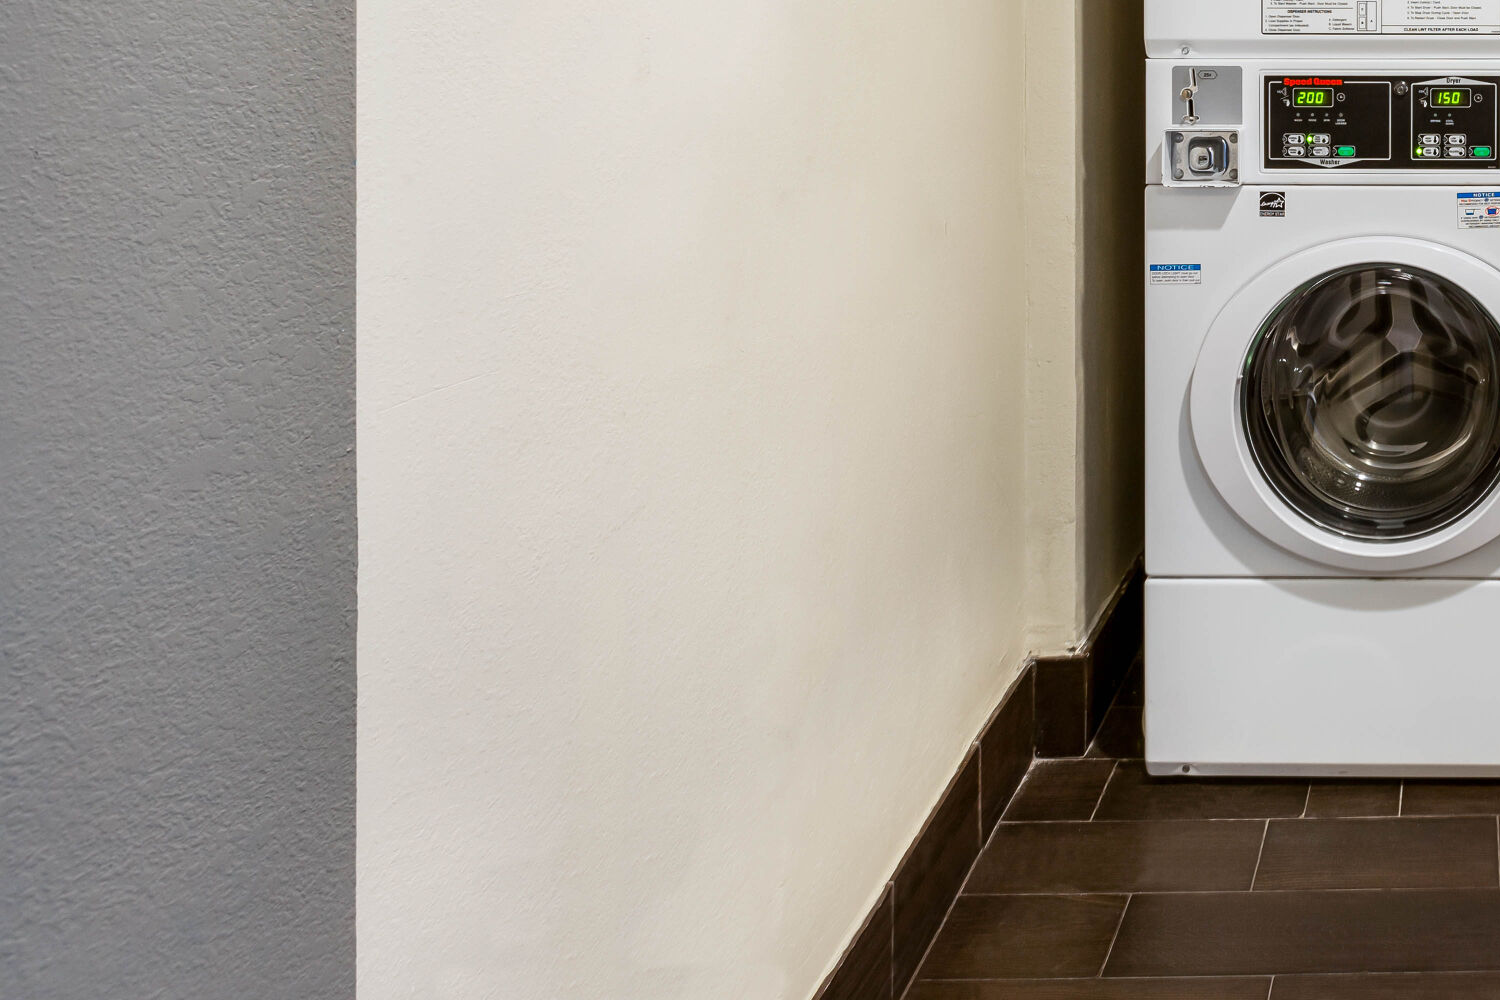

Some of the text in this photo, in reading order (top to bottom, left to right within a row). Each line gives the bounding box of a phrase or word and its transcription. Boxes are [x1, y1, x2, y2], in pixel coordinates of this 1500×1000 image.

[1284, 78, 1312, 86] Speed
[1297, 92, 1324, 104] 200
[1438, 92, 1460, 104] 150
